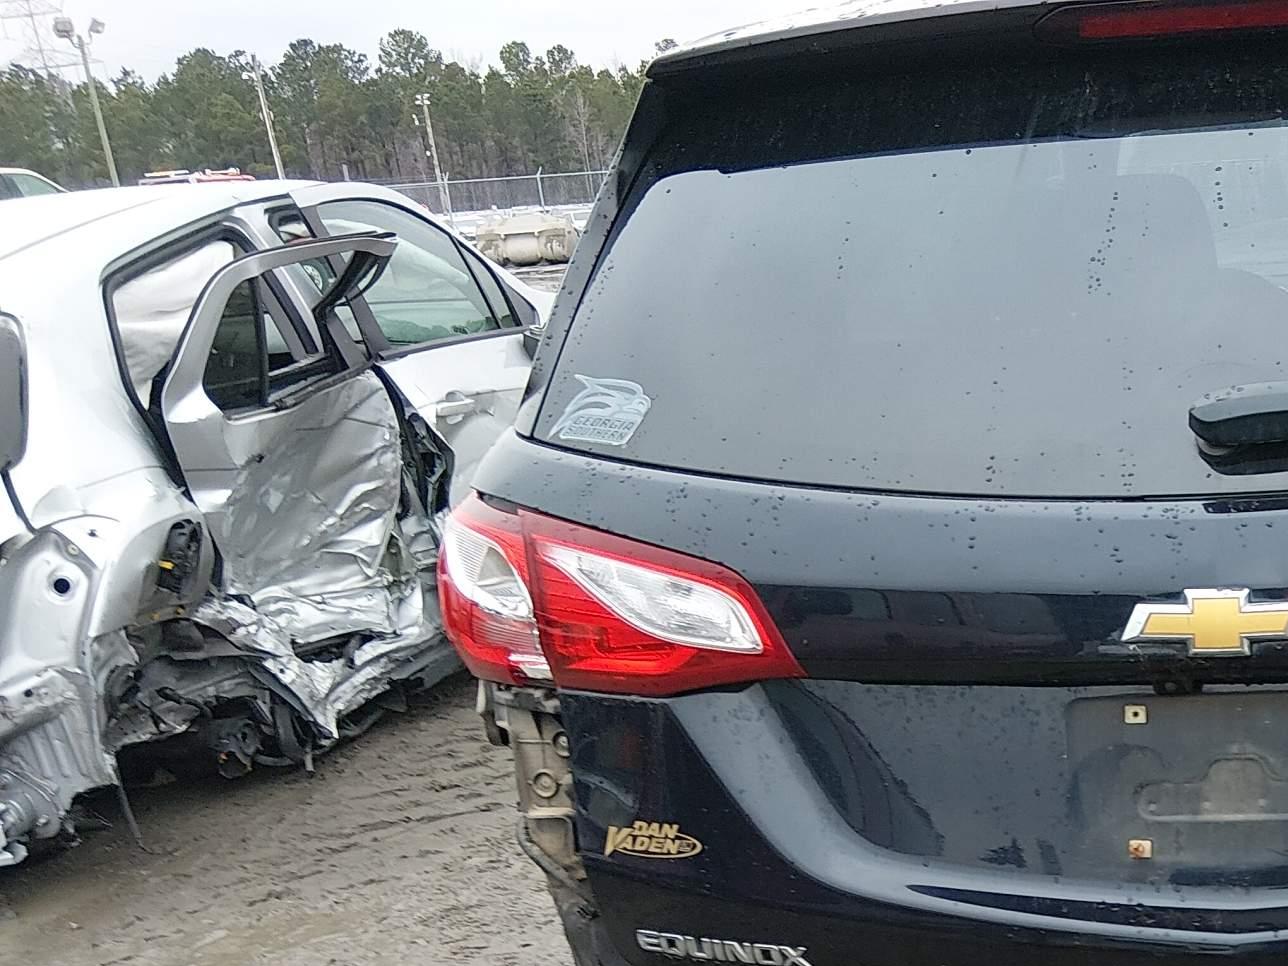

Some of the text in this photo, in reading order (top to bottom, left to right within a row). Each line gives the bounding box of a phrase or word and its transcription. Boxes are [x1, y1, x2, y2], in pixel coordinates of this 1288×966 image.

[573, 415, 636, 432] GEORGIA
[632, 820, 680, 839] DAN
[603, 825, 678, 857] VADEN
